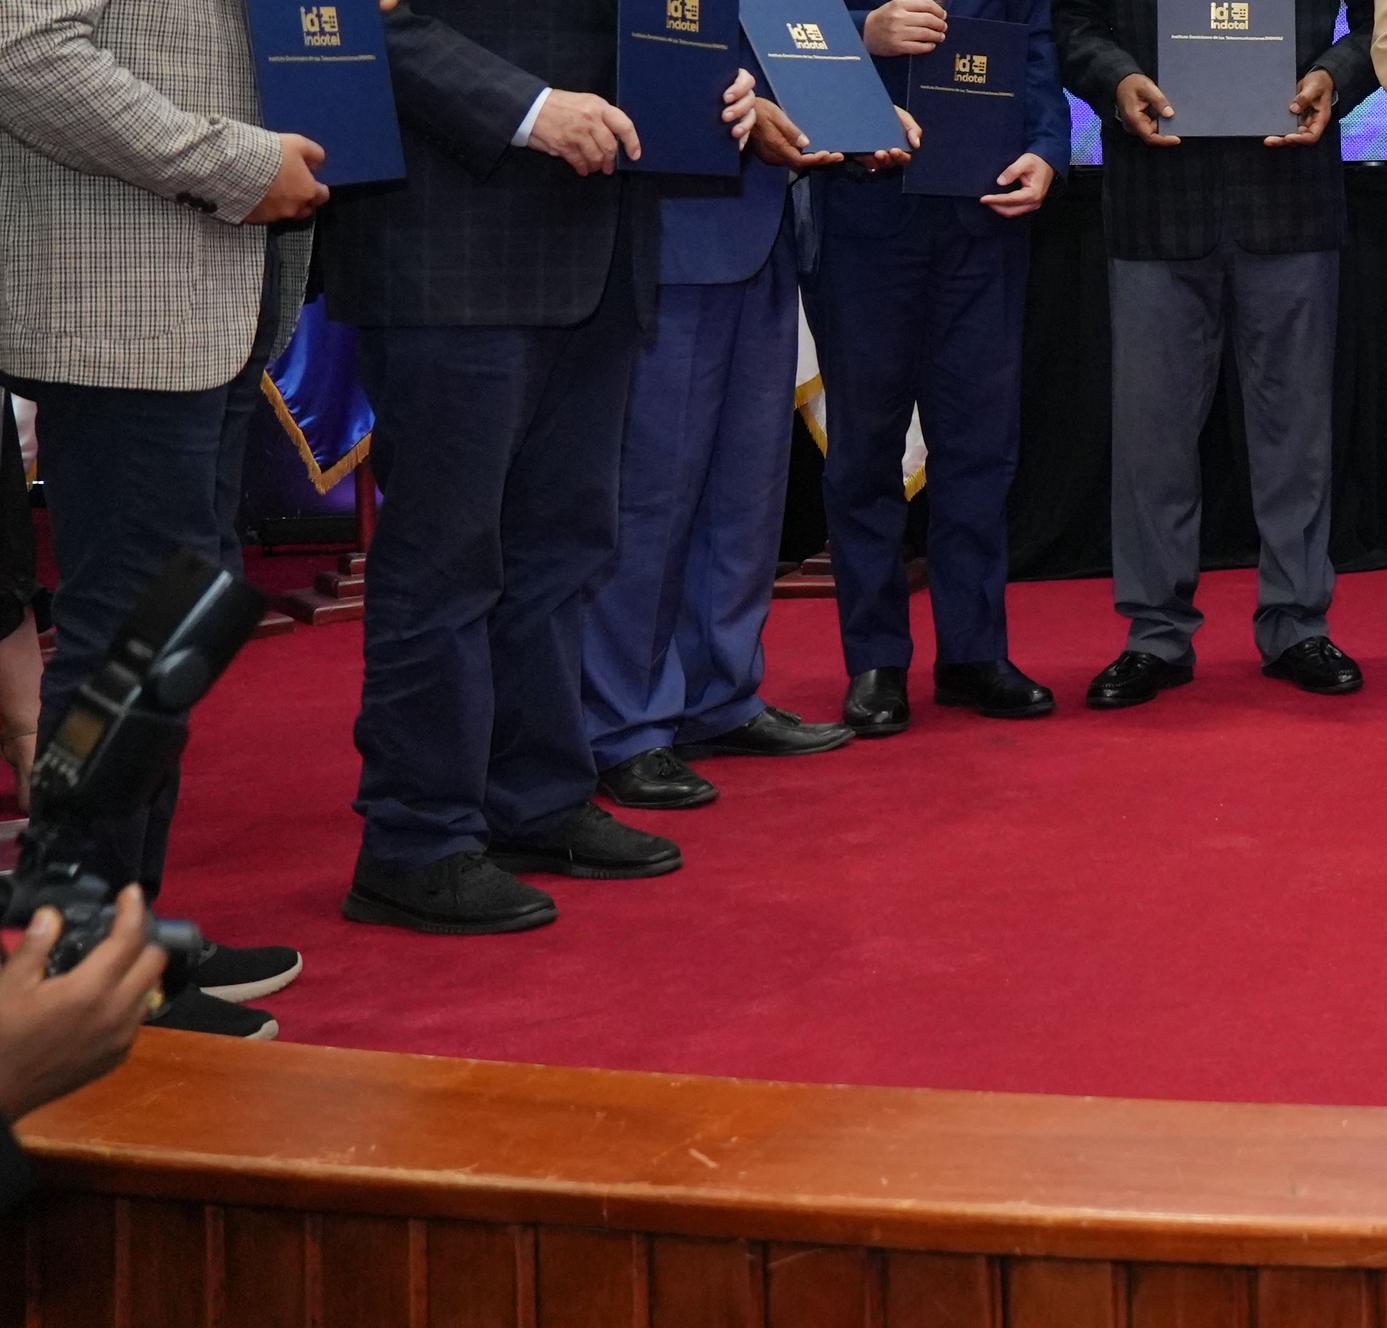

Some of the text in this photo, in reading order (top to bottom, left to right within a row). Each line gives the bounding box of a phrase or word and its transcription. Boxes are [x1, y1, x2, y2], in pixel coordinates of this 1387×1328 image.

[665, 18, 700, 33] indotel
[1210, 20, 1249, 30] indotel
[303, 32, 341, 46] indotel
[954, 72, 986, 84] indotel
